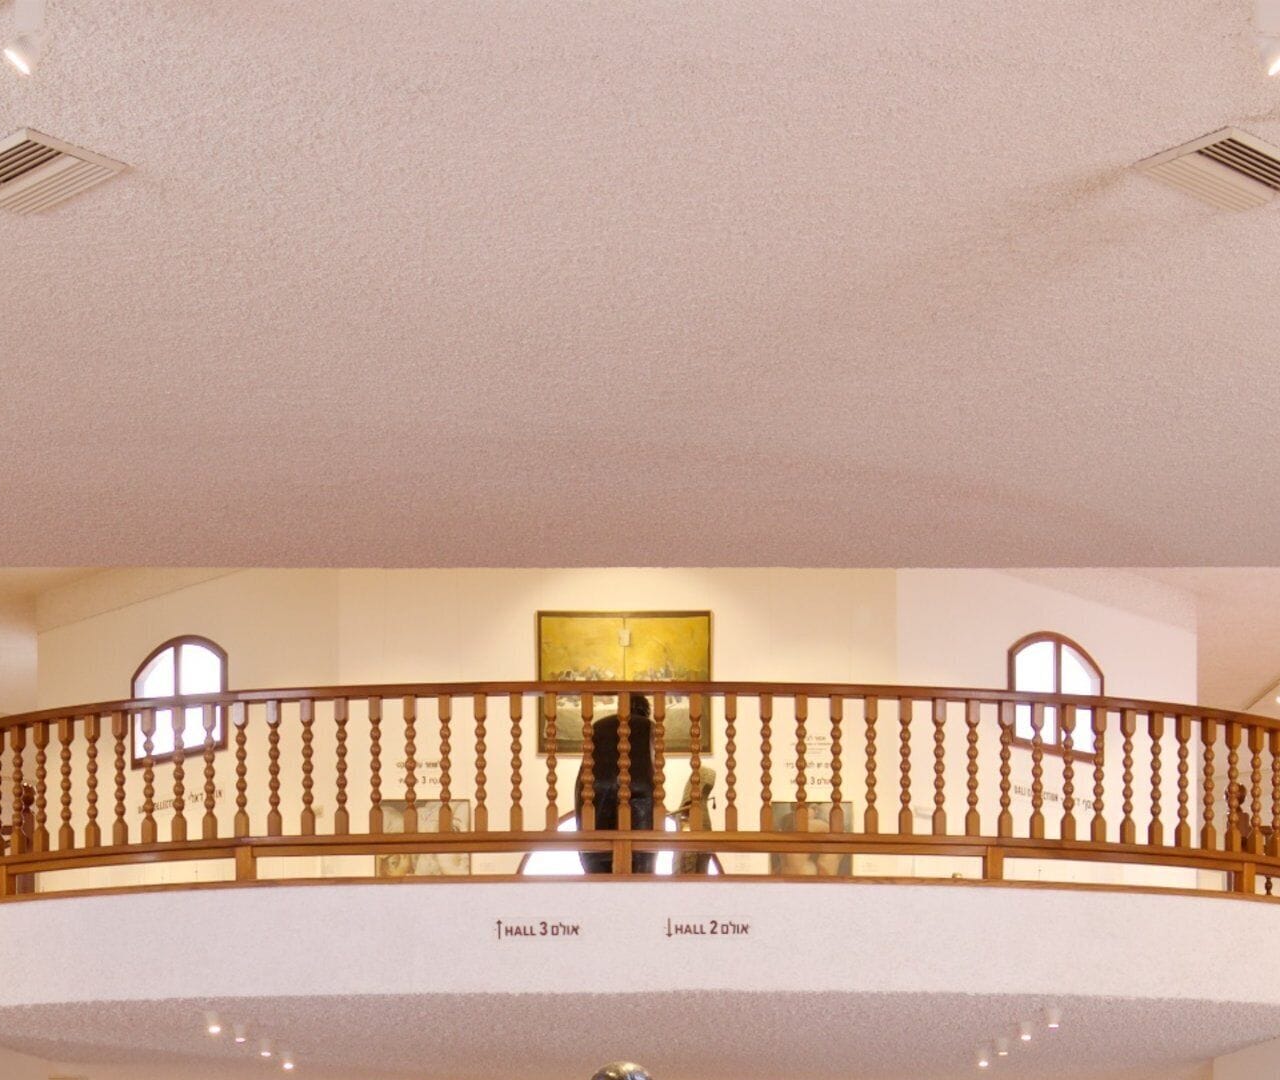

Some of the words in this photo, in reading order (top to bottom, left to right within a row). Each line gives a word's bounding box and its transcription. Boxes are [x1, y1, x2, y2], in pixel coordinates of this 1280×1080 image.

[504, 926, 536, 936] HALL
[539, 921, 548, 936] 3
[551, 921, 580, 936] אולם
[674, 924, 706, 935] HALL
[709, 920, 718, 935] 2
[721, 920, 749, 935] אולם
